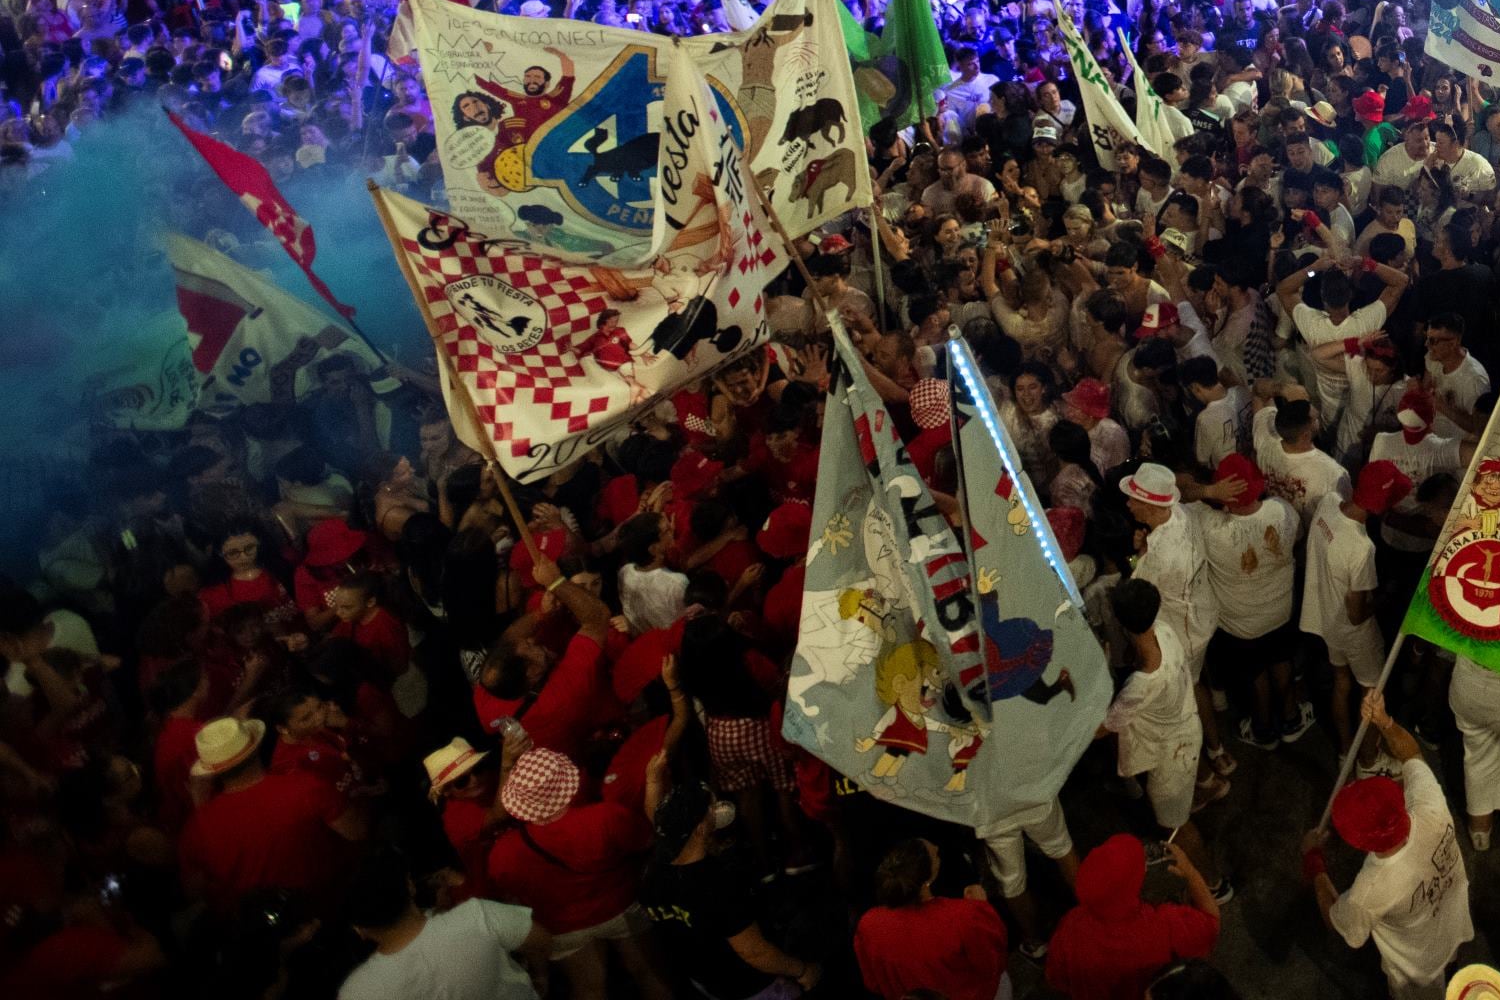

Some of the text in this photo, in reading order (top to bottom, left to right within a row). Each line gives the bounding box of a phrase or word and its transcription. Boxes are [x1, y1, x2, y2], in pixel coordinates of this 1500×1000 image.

[480, 276, 494, 287] TU
[496, 281, 535, 308] FIESTA
[495, 325, 544, 353] LOS REYES
[1442, 533, 1471, 561] PEÑA
